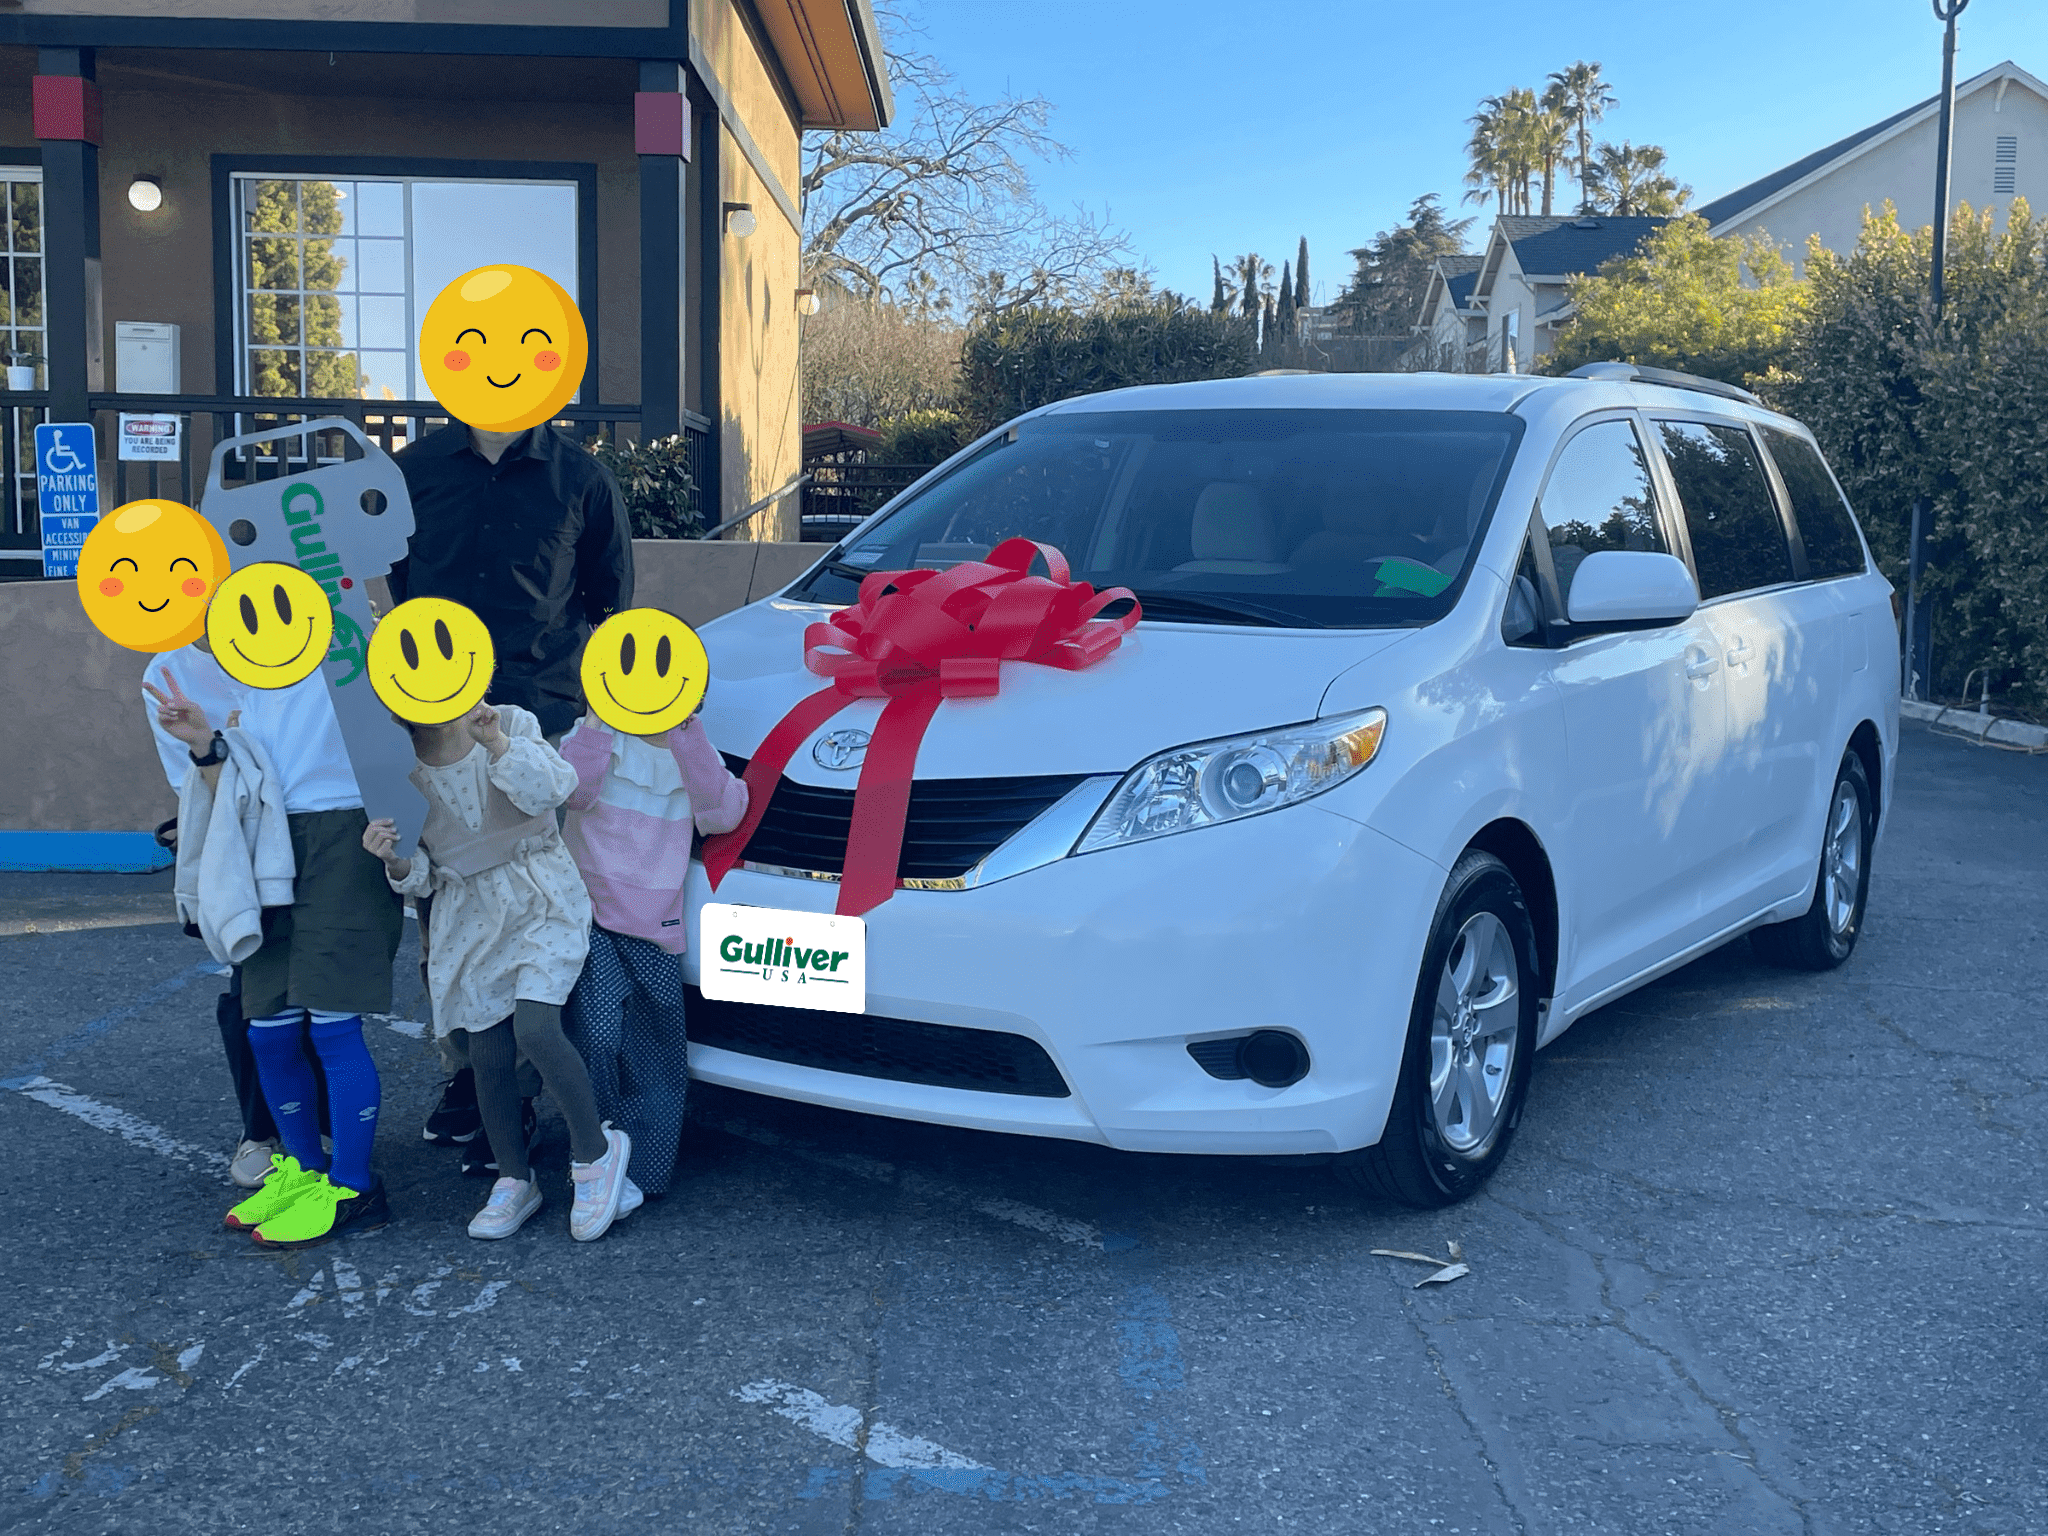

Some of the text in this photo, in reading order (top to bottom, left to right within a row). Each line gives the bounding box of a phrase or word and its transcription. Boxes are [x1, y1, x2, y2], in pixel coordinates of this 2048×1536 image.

[132, 424, 169, 432] WARNING
[140, 437, 153, 445] ARE
[155, 438, 176, 446] BEING
[131, 445, 168, 454] RECORDED
[40, 474, 95, 492] PARKING
[53, 495, 87, 512] ONLY
[61, 518, 80, 529] VAN
[45, 532, 90, 545] ACCESSIB
[52, 550, 81, 561] MINIM
[48, 566, 68, 577] FINE
